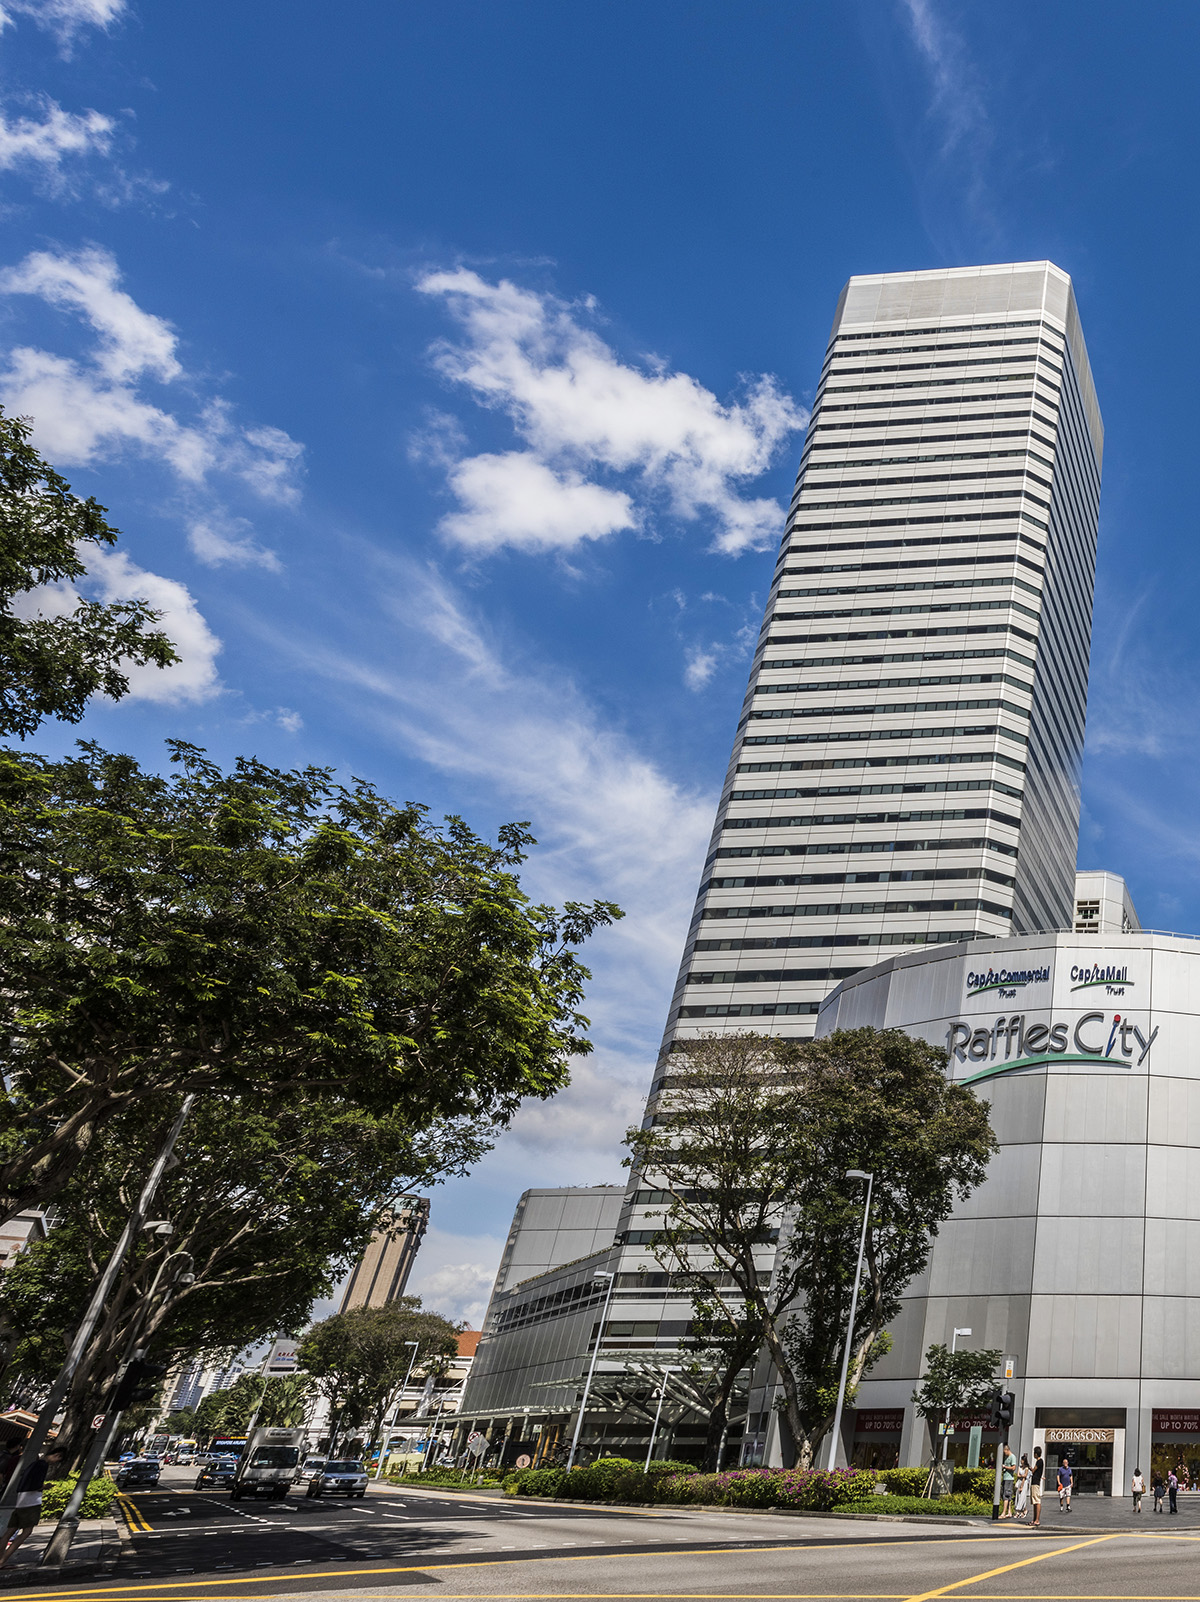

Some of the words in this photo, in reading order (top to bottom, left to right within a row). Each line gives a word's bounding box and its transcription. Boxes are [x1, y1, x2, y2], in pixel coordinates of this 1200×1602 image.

[967, 966, 1050, 988] CapitaCommercial
[1070, 963, 1128, 984] CapitaMall
[998, 988, 1017, 998] Trust
[1105, 985, 1125, 996] Trust
[948, 1014, 1069, 1061] Raffles
[1074, 1011, 1160, 1066] City
[874, 1421, 882, 1429] TO
[1160, 1421, 1170, 1430] UP
[1171, 1421, 1181, 1430] TO
[1183, 1421, 1198, 1430] 70%
[1050, 1431, 1107, 1441] ROBINSONS
